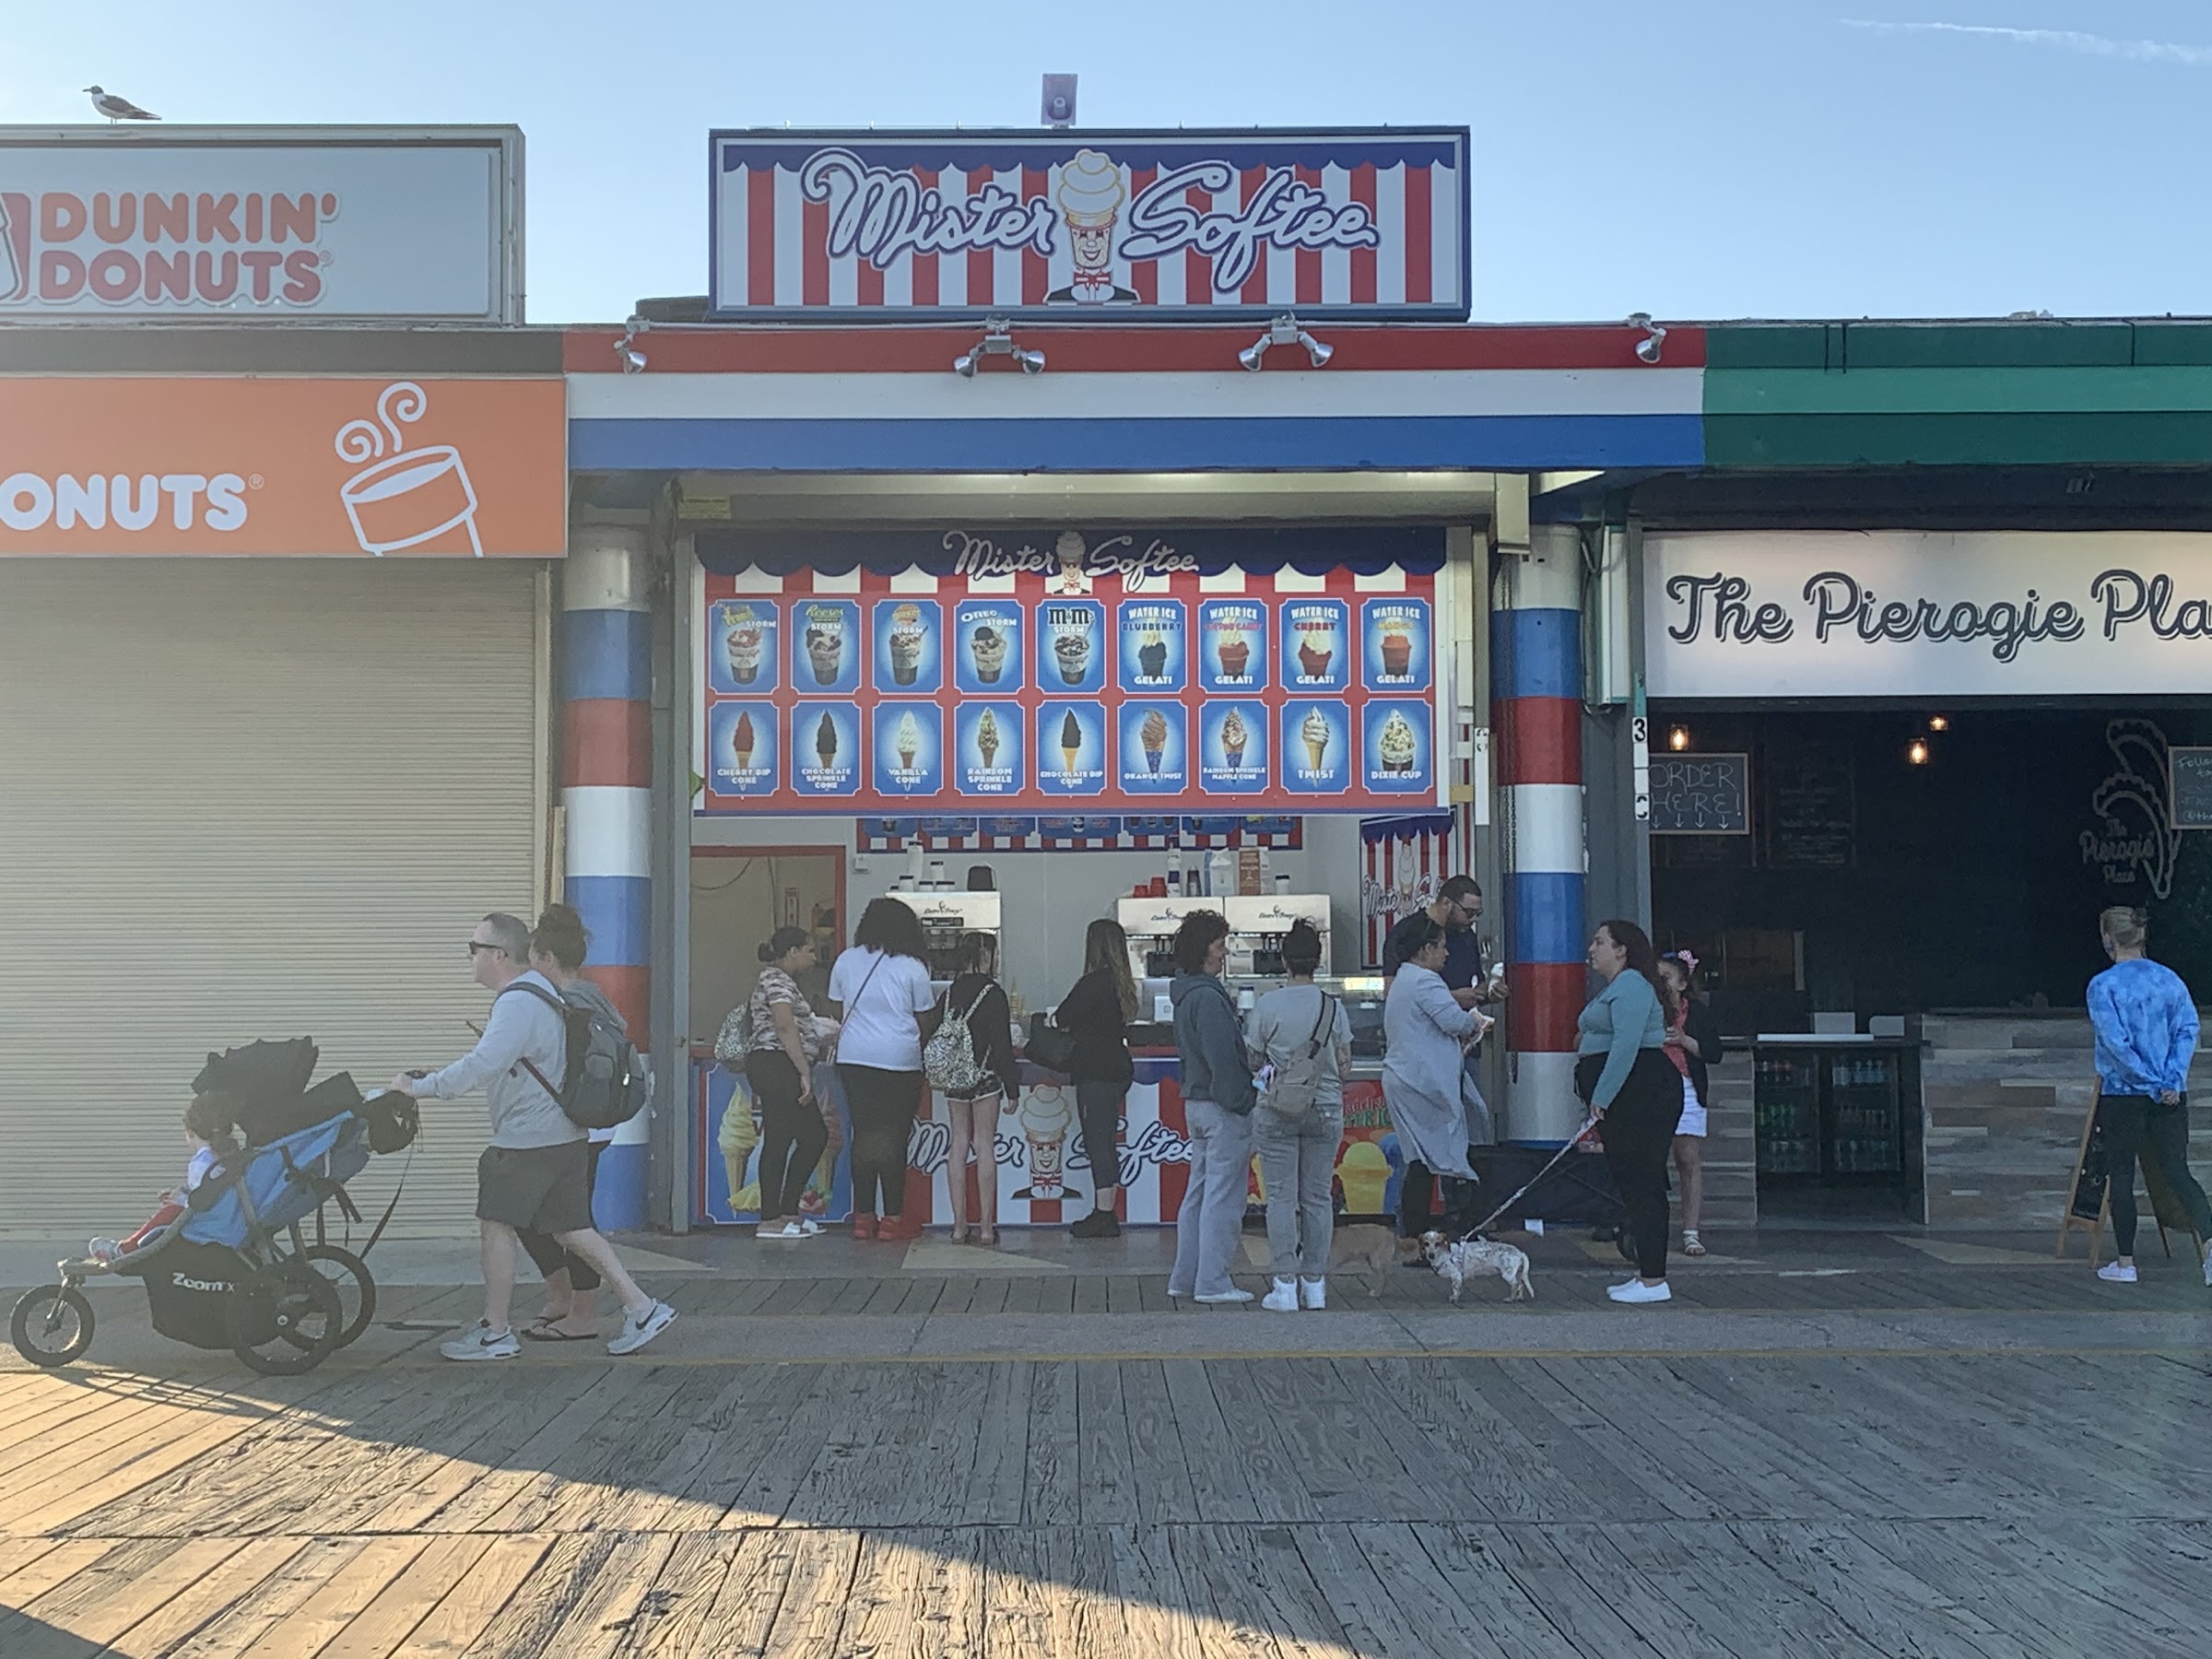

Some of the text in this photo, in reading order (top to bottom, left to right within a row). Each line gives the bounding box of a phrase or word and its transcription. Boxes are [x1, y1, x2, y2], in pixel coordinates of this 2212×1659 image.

[800, 147, 1380, 294] Mister Softee
[943, 530, 1199, 592] Mister Softee
[960, 610, 998, 622] OREO
[1128, 606, 1177, 619] WATER ICE
[1209, 606, 1258, 619] WATER ICE
[1291, 606, 1339, 619] WATER ICE
[1372, 606, 1420, 618] WATER ICE
[985, 618, 1018, 627] STORM
[1665, 571, 1794, 644] The
[1803, 571, 2085, 664] Pierogie
[746, 620, 777, 629] STORM
[810, 623, 842, 631] STORM
[1123, 622, 1182, 631] BLUEBERRY
[1293, 622, 1336, 631] CHERRY
[892, 627, 924, 635] STORM
[1053, 626, 1085, 634] STORM
[1134, 676, 1172, 685] GELATI
[1215, 676, 1253, 685] GELATI
[1296, 675, 1335, 684] GELATI
[1376, 674, 1416, 684] GELATI
[1633, 718, 1646, 743] 3
[731, 776, 757, 784] CONE
[1298, 770, 1335, 780] TWIST
[1371, 771, 1423, 780] DIXIE CUP
[1649, 762, 1735, 794] ORDER
[1651, 793, 1742, 817] HERE!
[172, 1272, 224, 1291] Zoom
